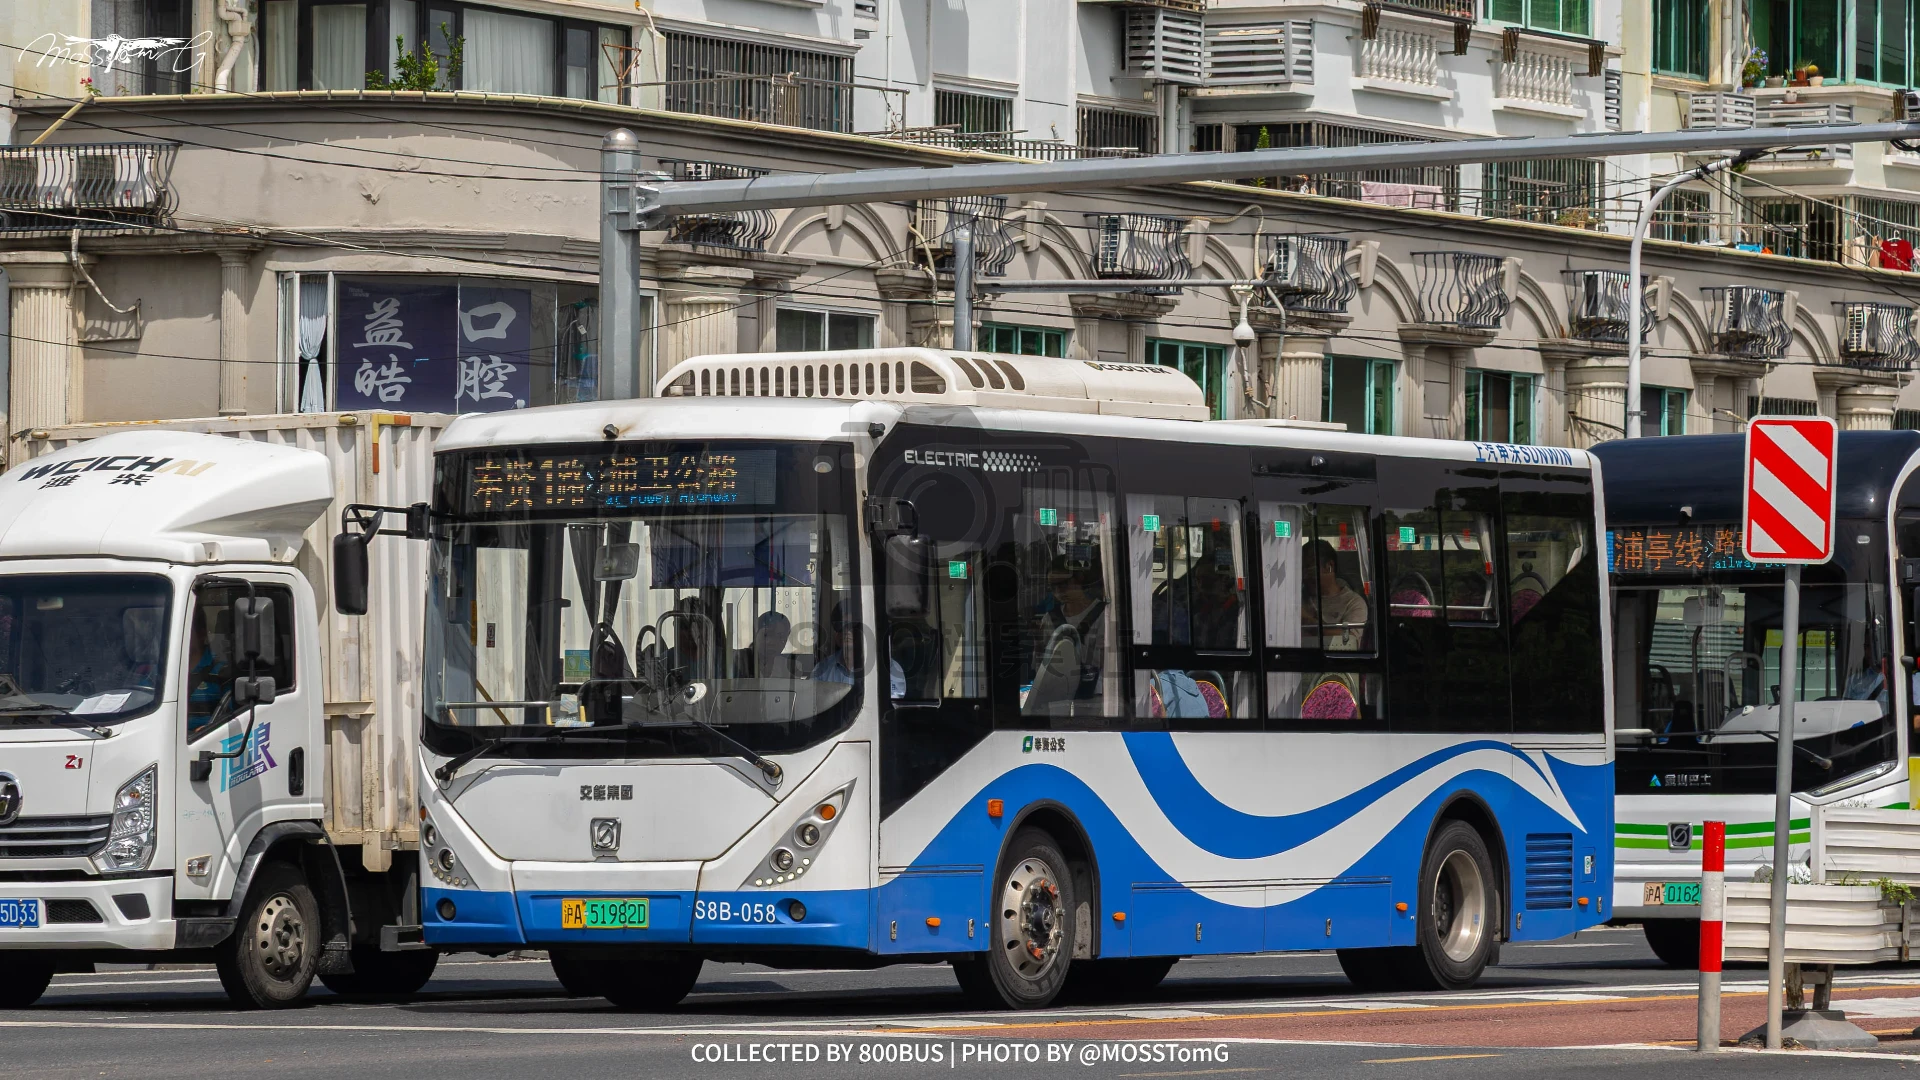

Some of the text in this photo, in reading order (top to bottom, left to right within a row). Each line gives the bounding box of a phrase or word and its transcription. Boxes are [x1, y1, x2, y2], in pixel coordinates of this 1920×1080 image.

[454, 301, 517, 402] 口腔
[904, 449, 980, 468] ELECTRIC
[1712, 556, 1757, 571] ailway
[1645, 886, 1701, 903] 沪A0162
[0, 903, 37, 923] 5D33
[695, 900, 776, 924] S8B-058
